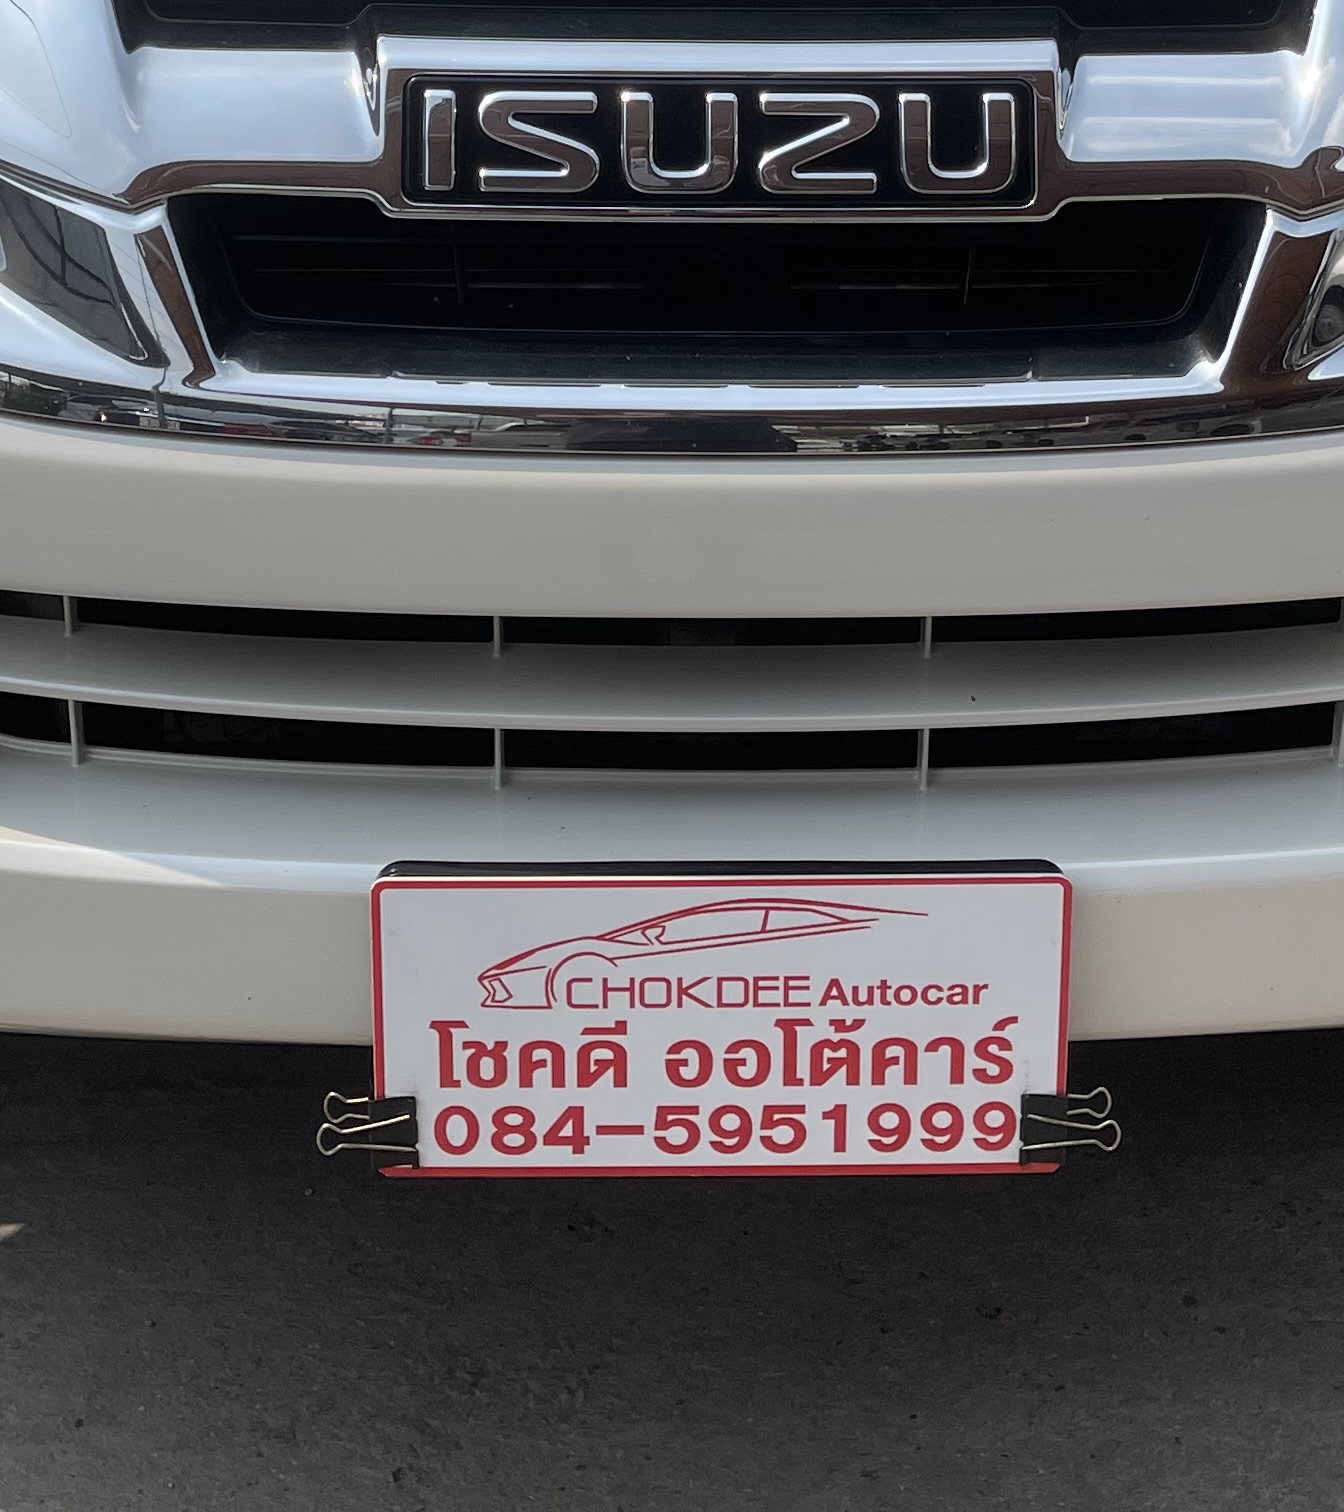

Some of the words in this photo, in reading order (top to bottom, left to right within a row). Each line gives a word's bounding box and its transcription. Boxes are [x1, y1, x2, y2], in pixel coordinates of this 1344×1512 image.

[422, 90, 1016, 194] ISUZU
[565, 974, 812, 1011] CHOKDEE
[818, 976, 990, 1008] Autocar
[428, 1018, 629, 1090] โชคดี
[663, 1014, 1020, 1090] ออโต้คาร์
[432, 1099, 1018, 1157] 084-5951999
